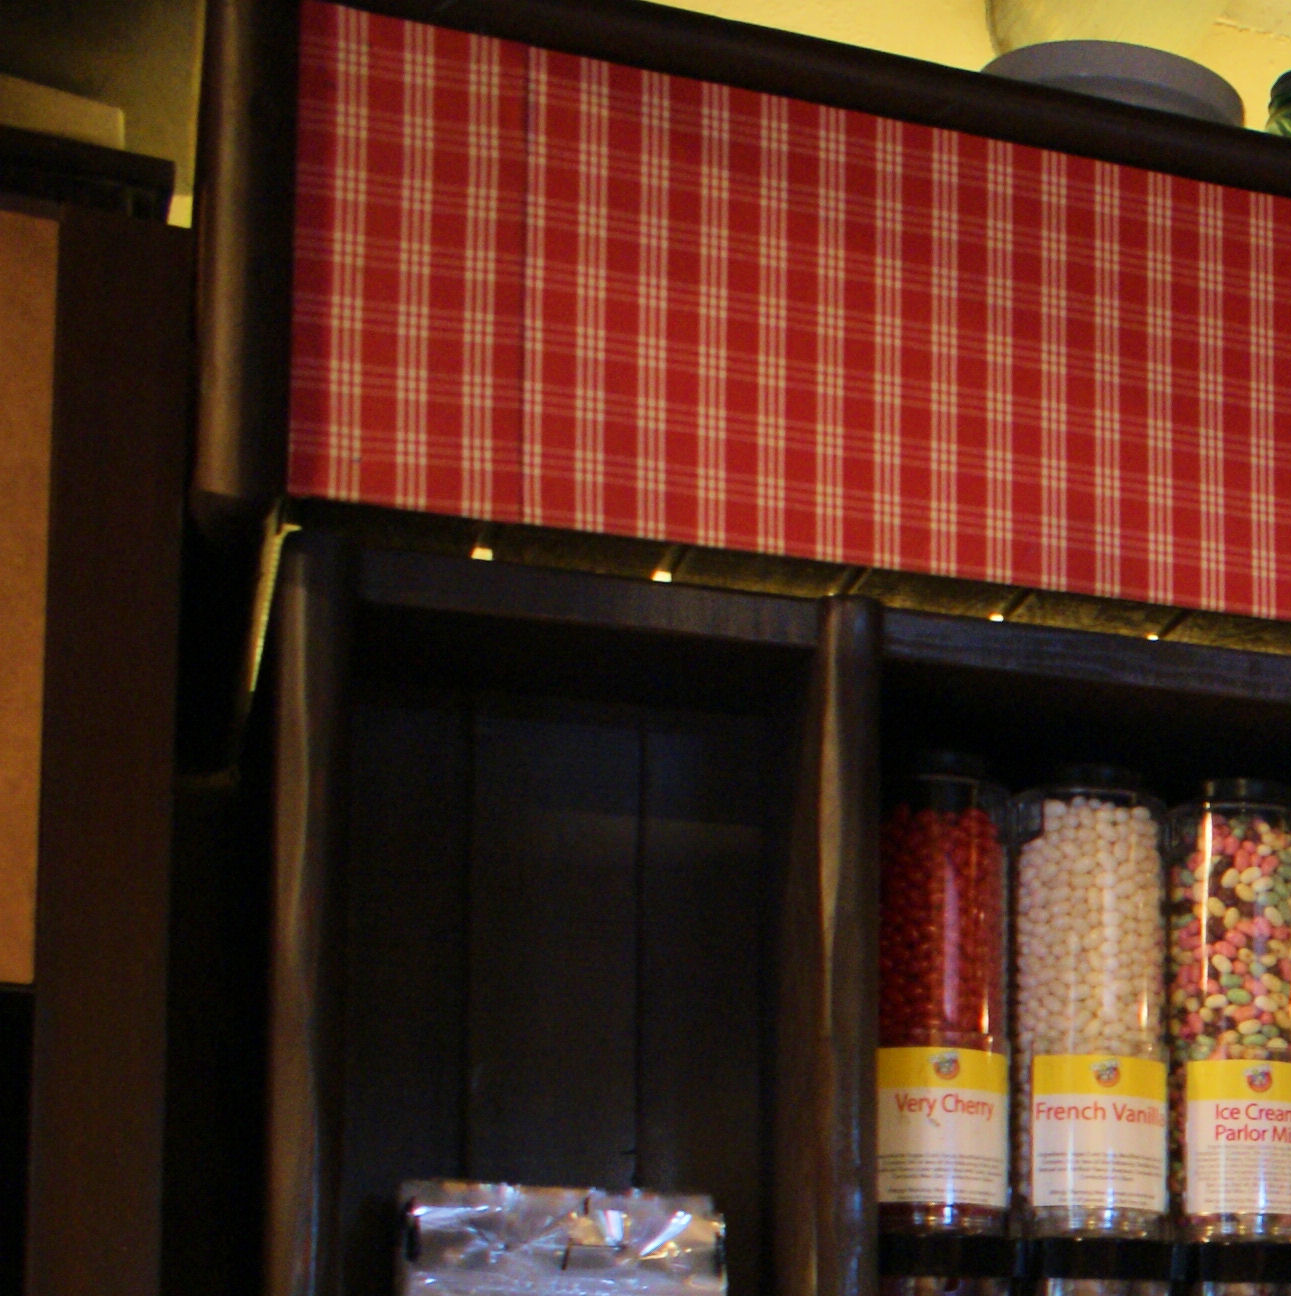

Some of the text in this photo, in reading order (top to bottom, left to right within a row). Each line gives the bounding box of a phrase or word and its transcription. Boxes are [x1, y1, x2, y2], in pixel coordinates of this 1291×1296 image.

[894, 1093, 995, 1121] Very Cherry
[1036, 1102, 1106, 1121] French
[1214, 1103, 1241, 1121] Ice
[1214, 1124, 1268, 1142] Parlor
